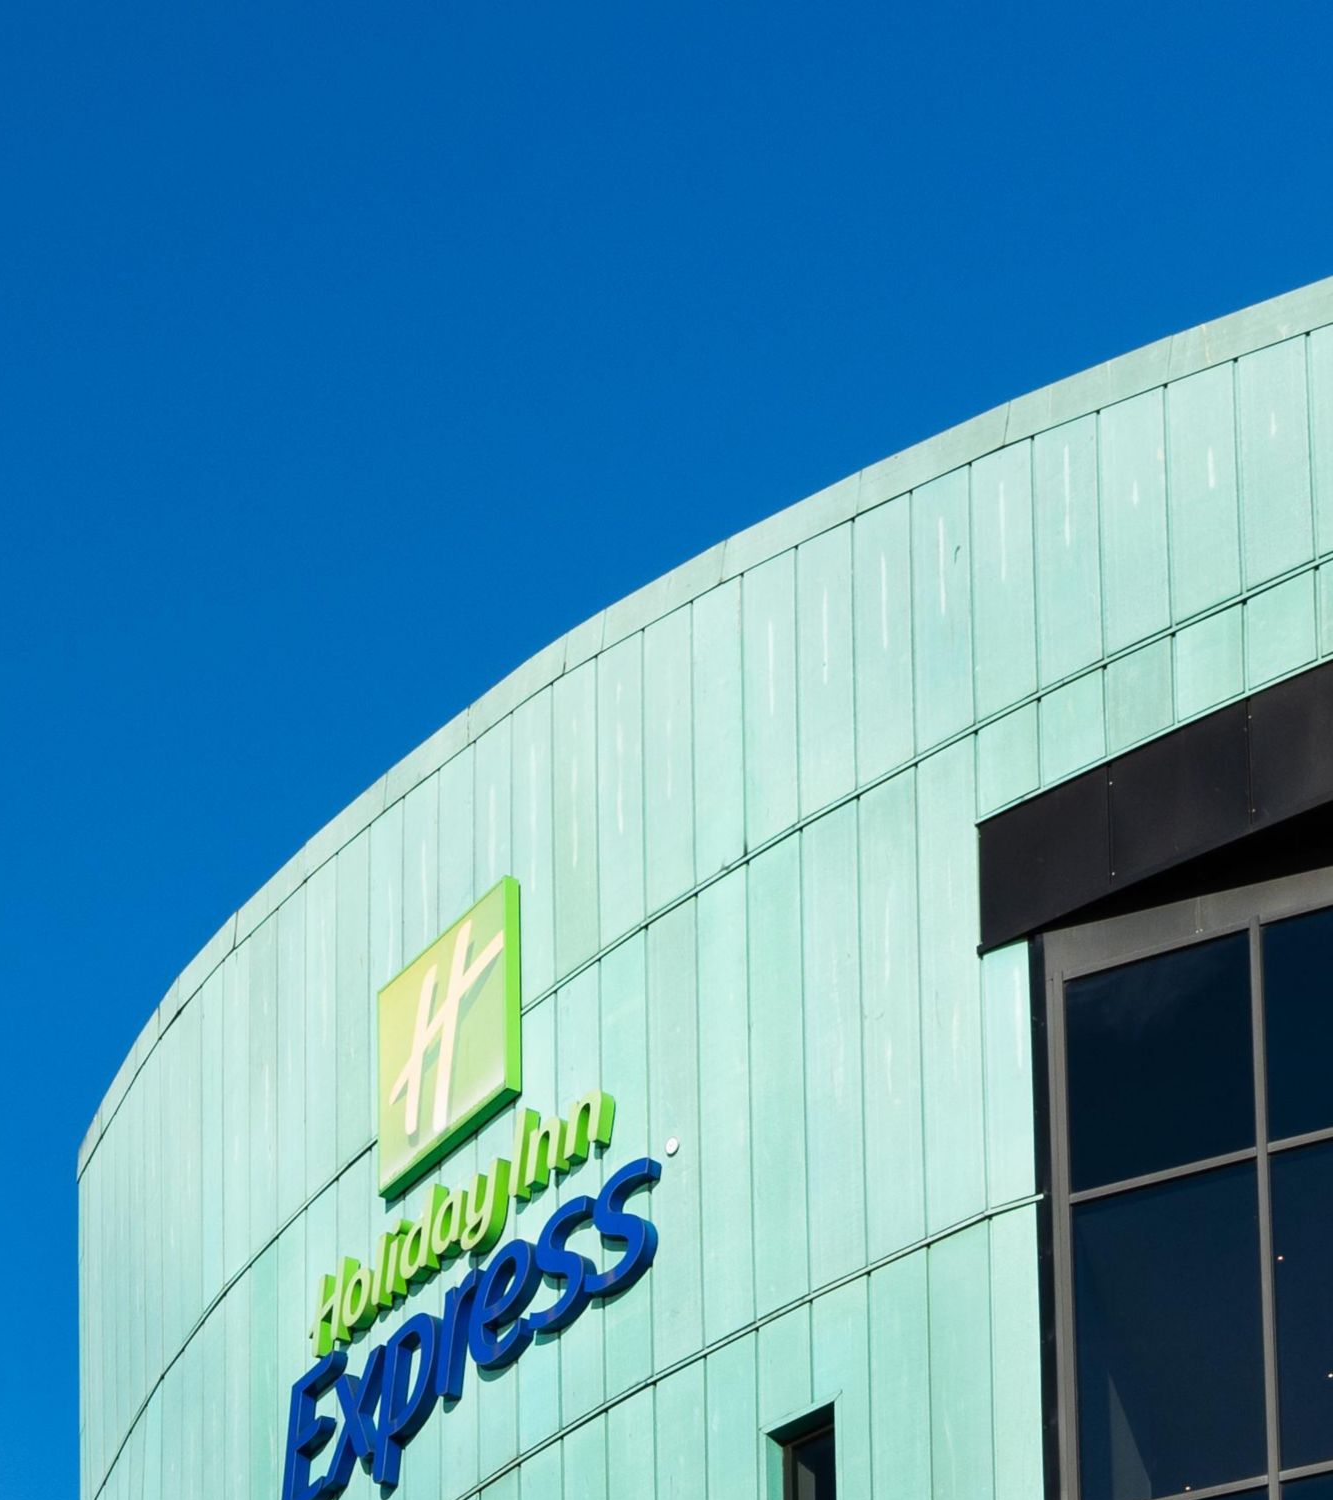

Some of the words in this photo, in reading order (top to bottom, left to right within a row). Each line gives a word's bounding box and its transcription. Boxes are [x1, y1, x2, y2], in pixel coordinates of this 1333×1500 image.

[388, 918, 504, 1137] H
[309, 1158, 511, 1358] Holiday
[508, 1090, 615, 1200] Inn
